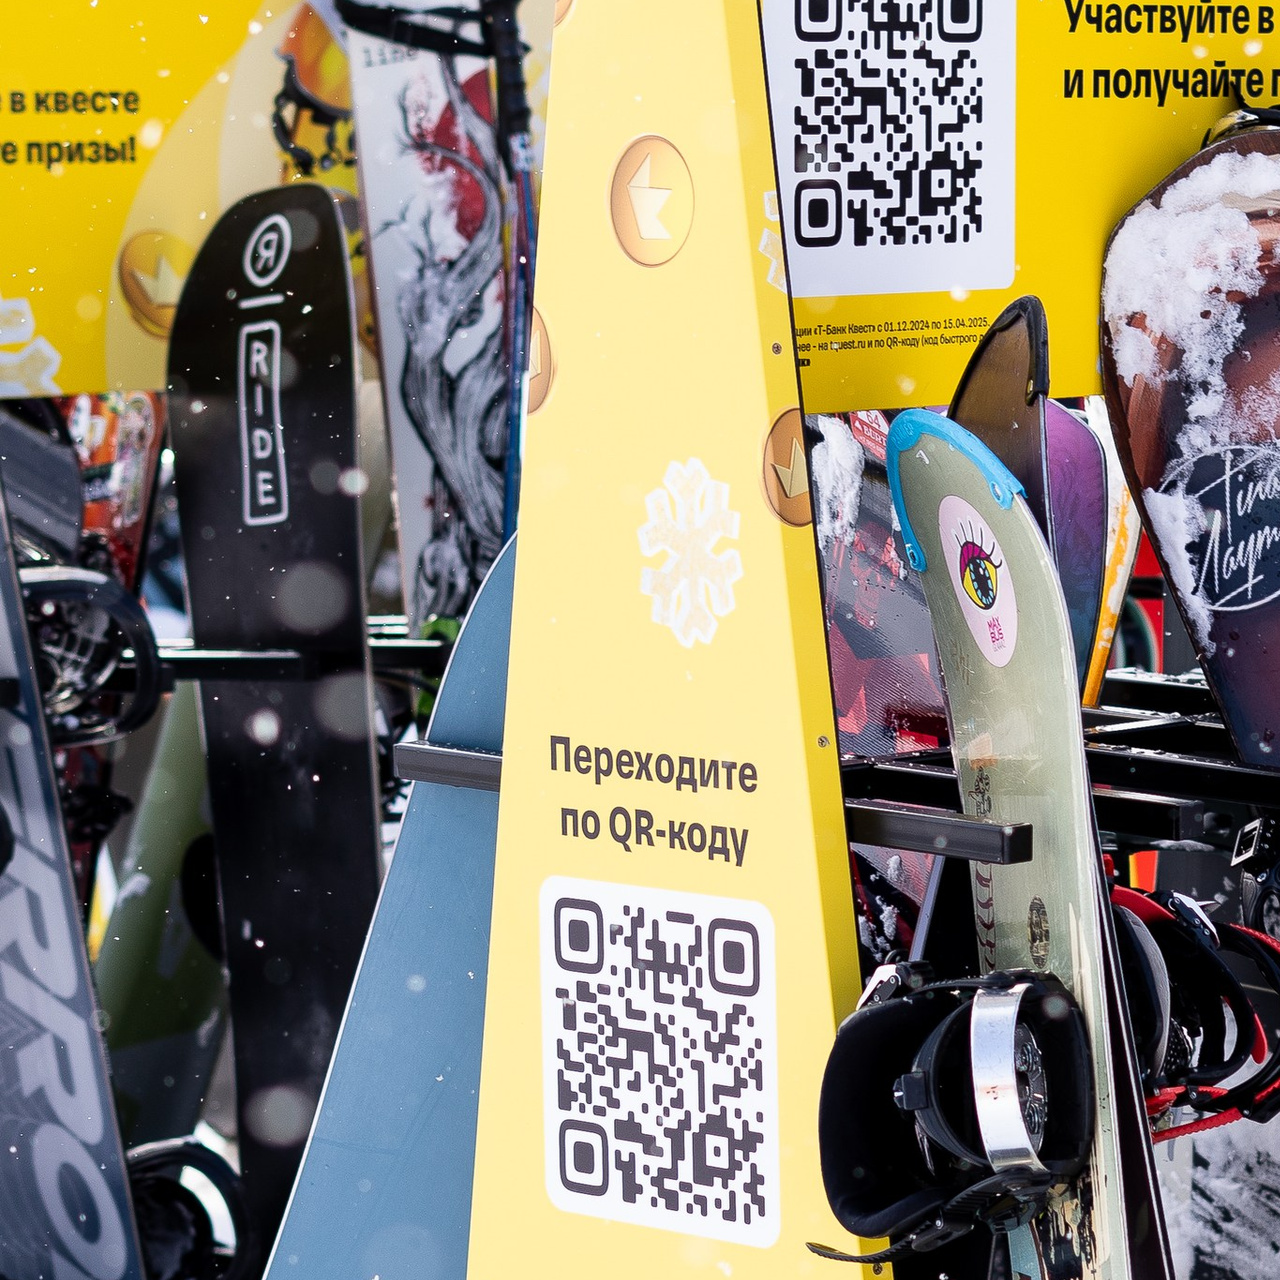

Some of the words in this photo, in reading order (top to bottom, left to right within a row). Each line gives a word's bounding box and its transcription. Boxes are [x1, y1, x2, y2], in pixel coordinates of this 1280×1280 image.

[1258, 5, 1274, 34] в
[1063, 69, 1084, 98] и
[1093, 60, 1264, 107] получайте
[10, 92, 26, 113] в
[35, 91, 139, 113] квесте
[27, 136, 136, 170] призы!
[884, 320, 930, 332] 01.12.2024
[932, 321, 941, 330] по
[943, 317, 990, 329] 15.04.2025.
[818, 342, 828, 351] на
[868, 340, 873, 348] и
[874, 339, 884, 348] по
[886, 336, 919, 349] QR-коду
[922, 335, 939, 346] (код
[940, 333, 977, 346] быстрого
[250, 338, 277, 506] RIDE
[863, 425, 888, 447] BURT
[550, 735, 757, 793] Переходите
[561, 807, 600, 840] по
[609, 806, 749, 867] QR-коду
